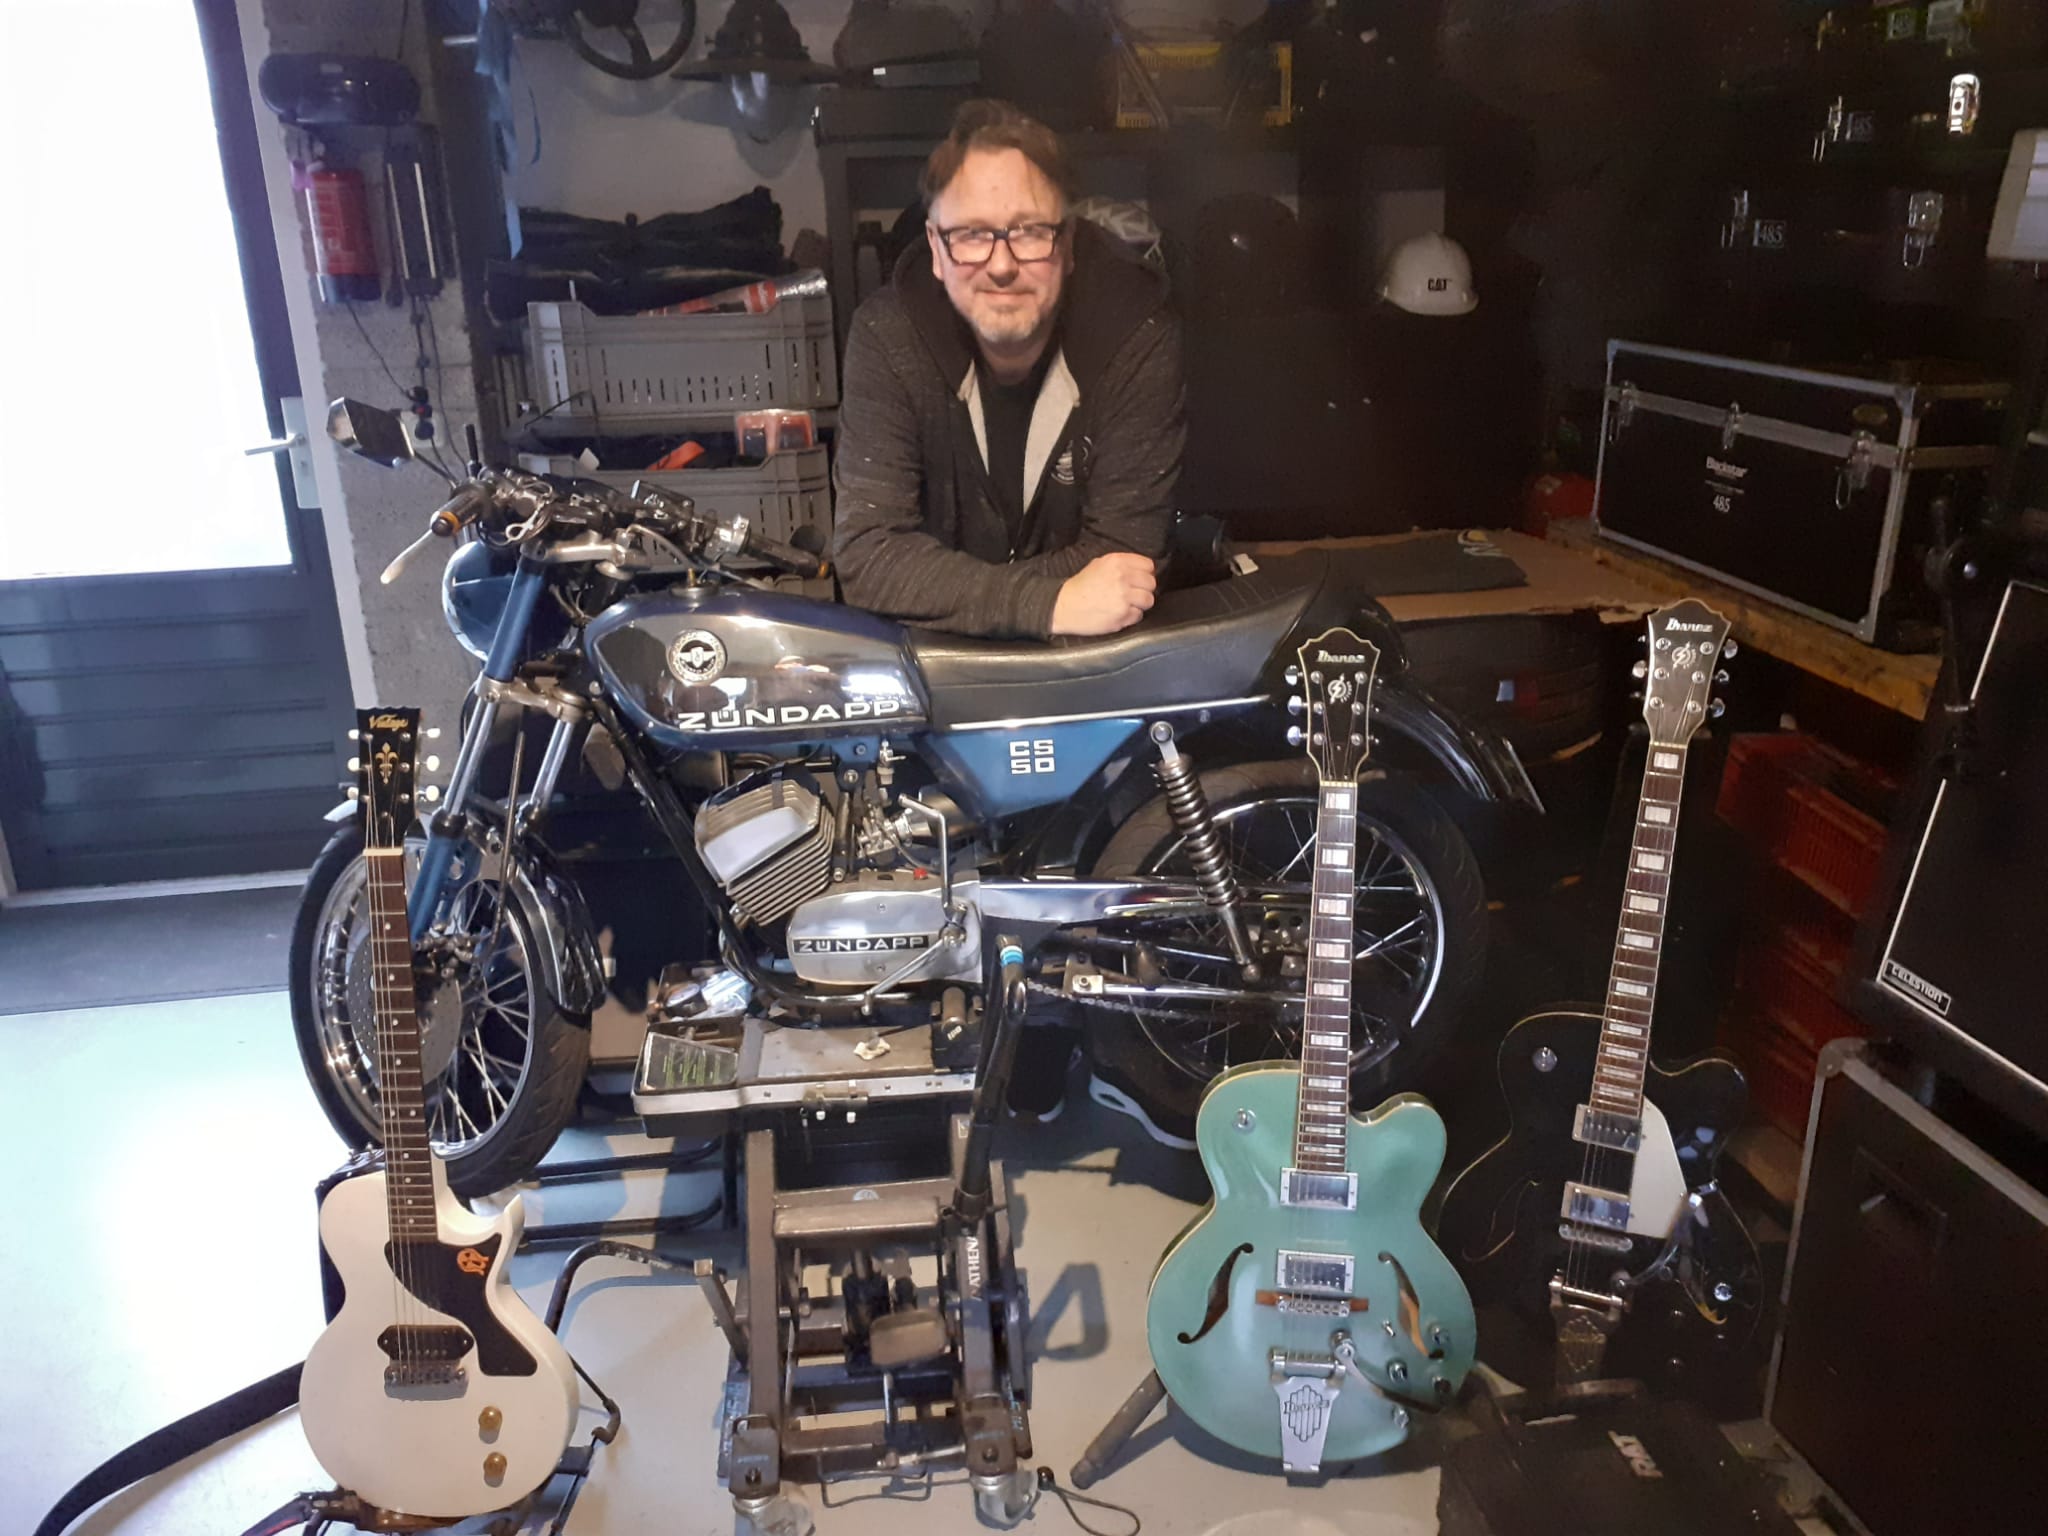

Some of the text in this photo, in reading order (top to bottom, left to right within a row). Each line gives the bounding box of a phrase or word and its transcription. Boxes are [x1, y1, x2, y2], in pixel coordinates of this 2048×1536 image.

[1428, 278, 1448, 291] CAT
[1713, 495, 1731, 512] 485
[1665, 618, 1713, 632] Ibanez
[1316, 650, 1365, 663] Ibanez
[1010, 739, 1054, 757] CS
[1011, 757, 1055, 774] 50
